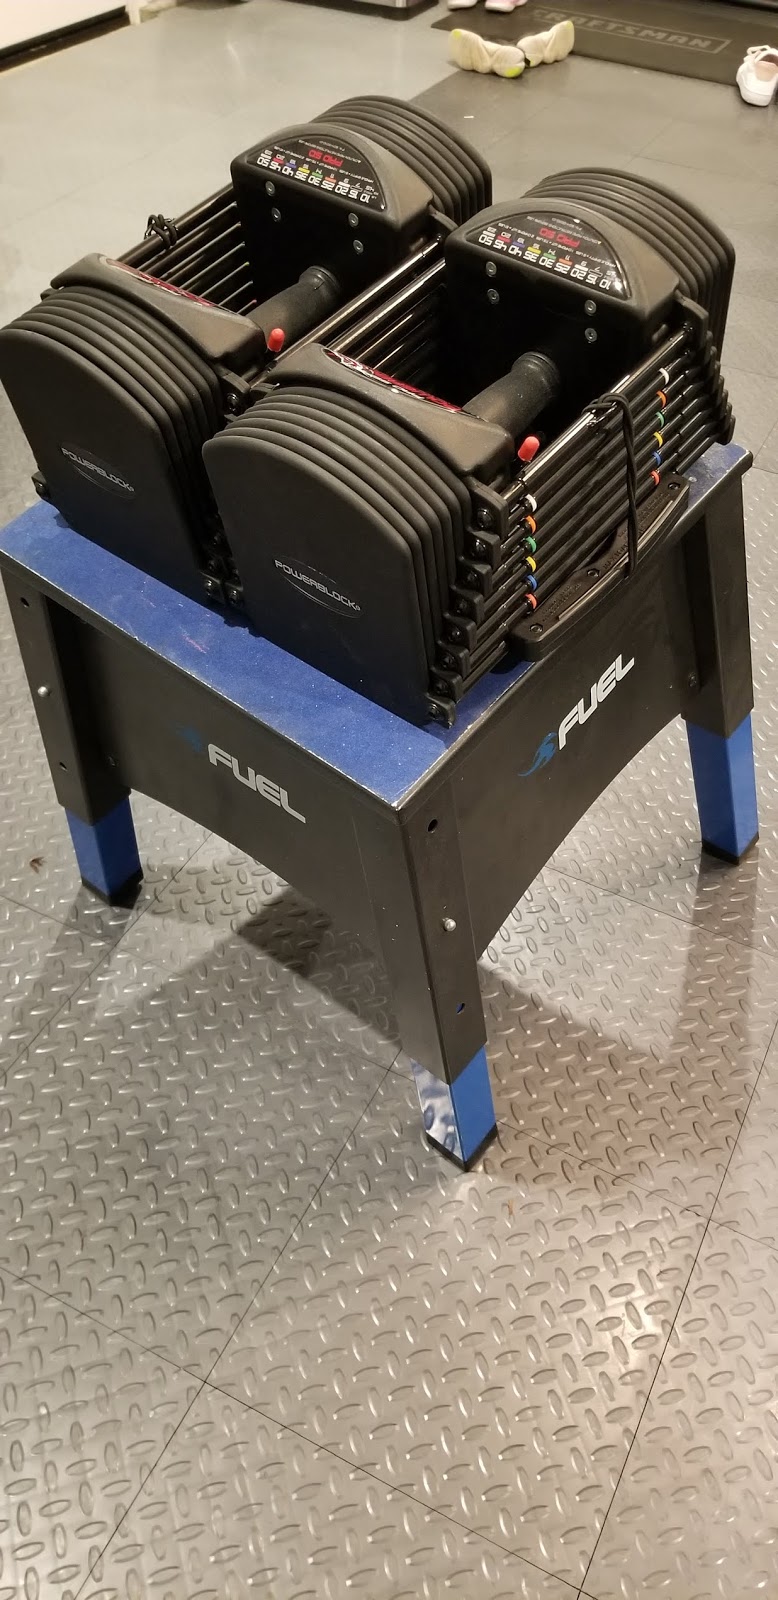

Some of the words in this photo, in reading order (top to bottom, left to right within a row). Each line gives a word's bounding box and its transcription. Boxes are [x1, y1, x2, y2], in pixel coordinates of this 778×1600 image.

[533, 10, 712, 48] CRAFTSMAN
[308, 149, 323, 160] 50
[257, 156, 270, 167] 50
[269, 161, 281, 171] 45
[322, 155, 343, 167] PRO
[281, 166, 294, 176] 40
[294, 171, 308, 181] 35
[308, 175, 322, 186] 30
[320, 180, 335, 190] 25
[334, 185, 349, 196] 20
[348, 190, 358, 199] 15
[360, 194, 370, 203] 10
[539, 227, 556, 239] 50
[478, 234, 494, 246] 50
[493, 239, 507, 251] 45
[556, 234, 580, 248] PRO
[508, 245, 522, 257] 40
[523, 250, 539, 262] 35
[538, 256, 555, 268] 30
[554, 262, 570, 274] 25
[570, 268, 587, 280] 20
[585, 274, 598, 285] 15
[599, 279, 611, 290] 10
[61, 446, 132, 491] POWERBLOCK
[274, 558, 357, 611] POWERBLOCK
[558, 654, 635, 751] FUEL
[207, 743, 306, 823] FUEL
